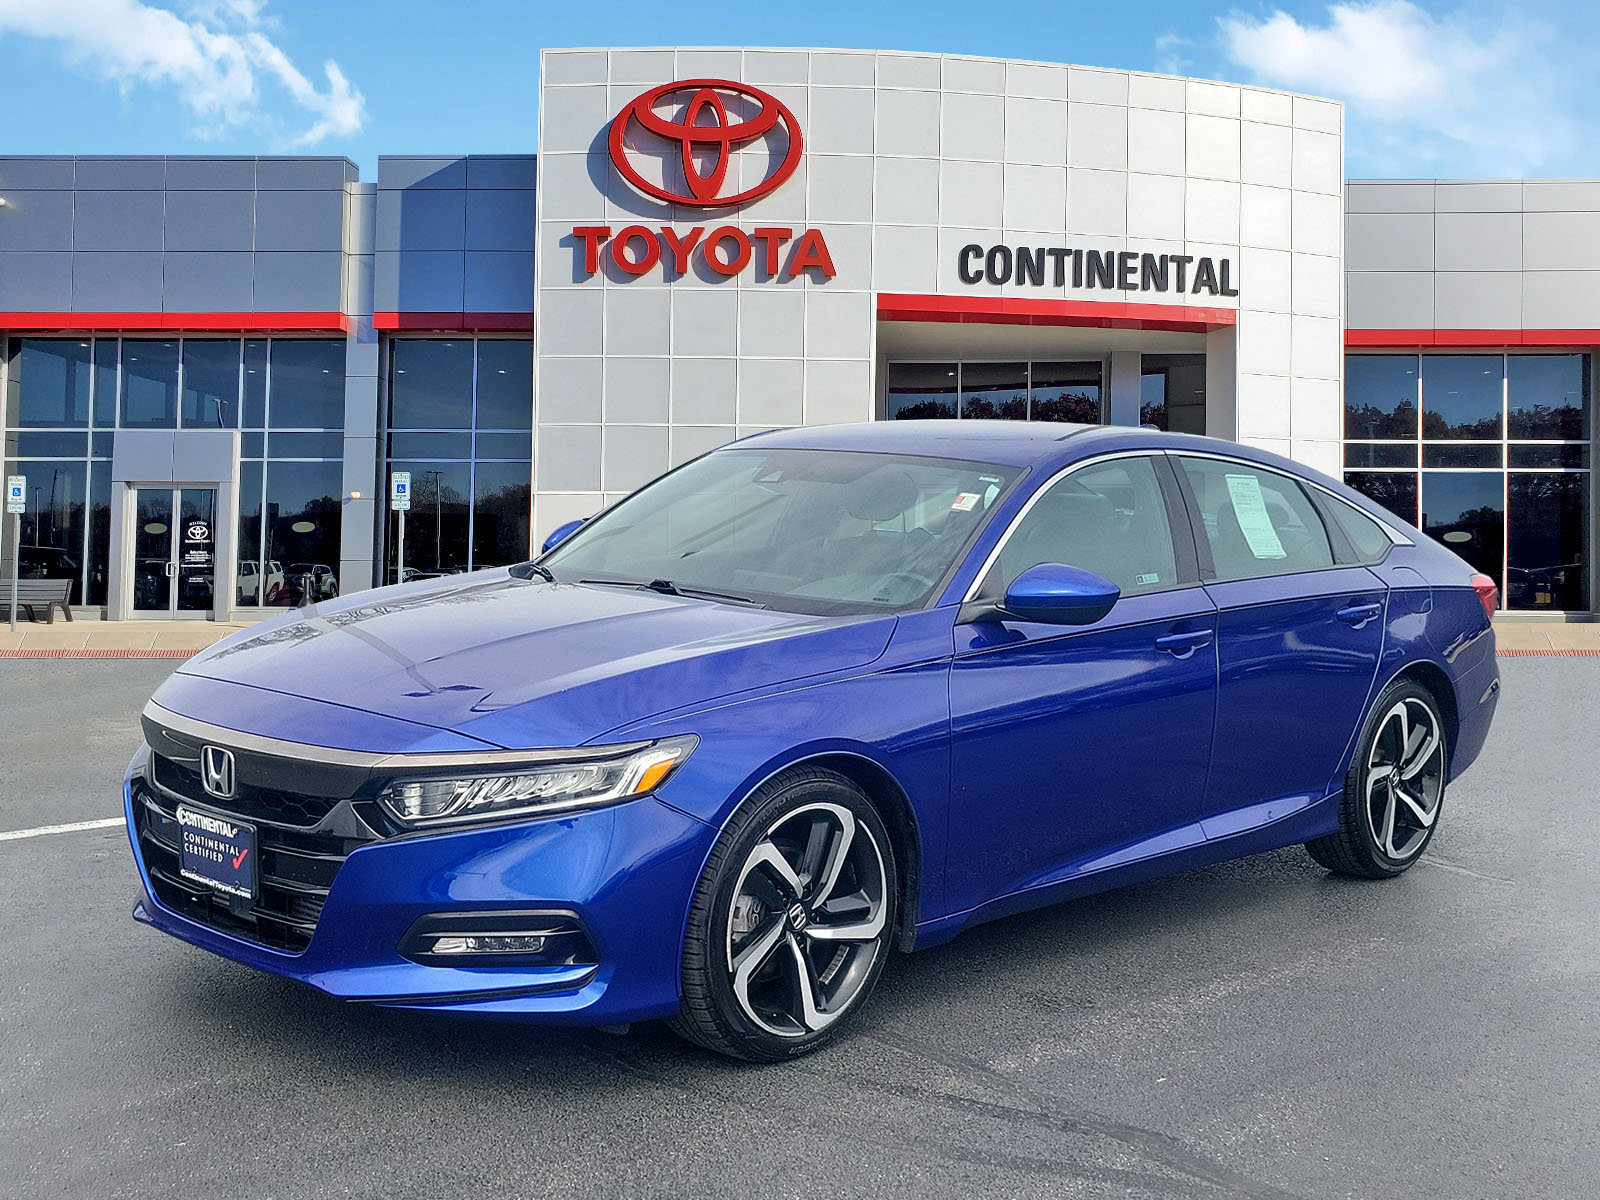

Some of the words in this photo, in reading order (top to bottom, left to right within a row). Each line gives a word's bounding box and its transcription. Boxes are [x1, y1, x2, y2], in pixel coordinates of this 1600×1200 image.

[573, 226, 836, 277] TOYOTA
[958, 244, 1239, 297] CONTINENTAL
[176, 807, 234, 838] CONTINENTAL
[183, 831, 240, 857] CONTINENTAL
[184, 843, 223, 863] CERTIFIED
